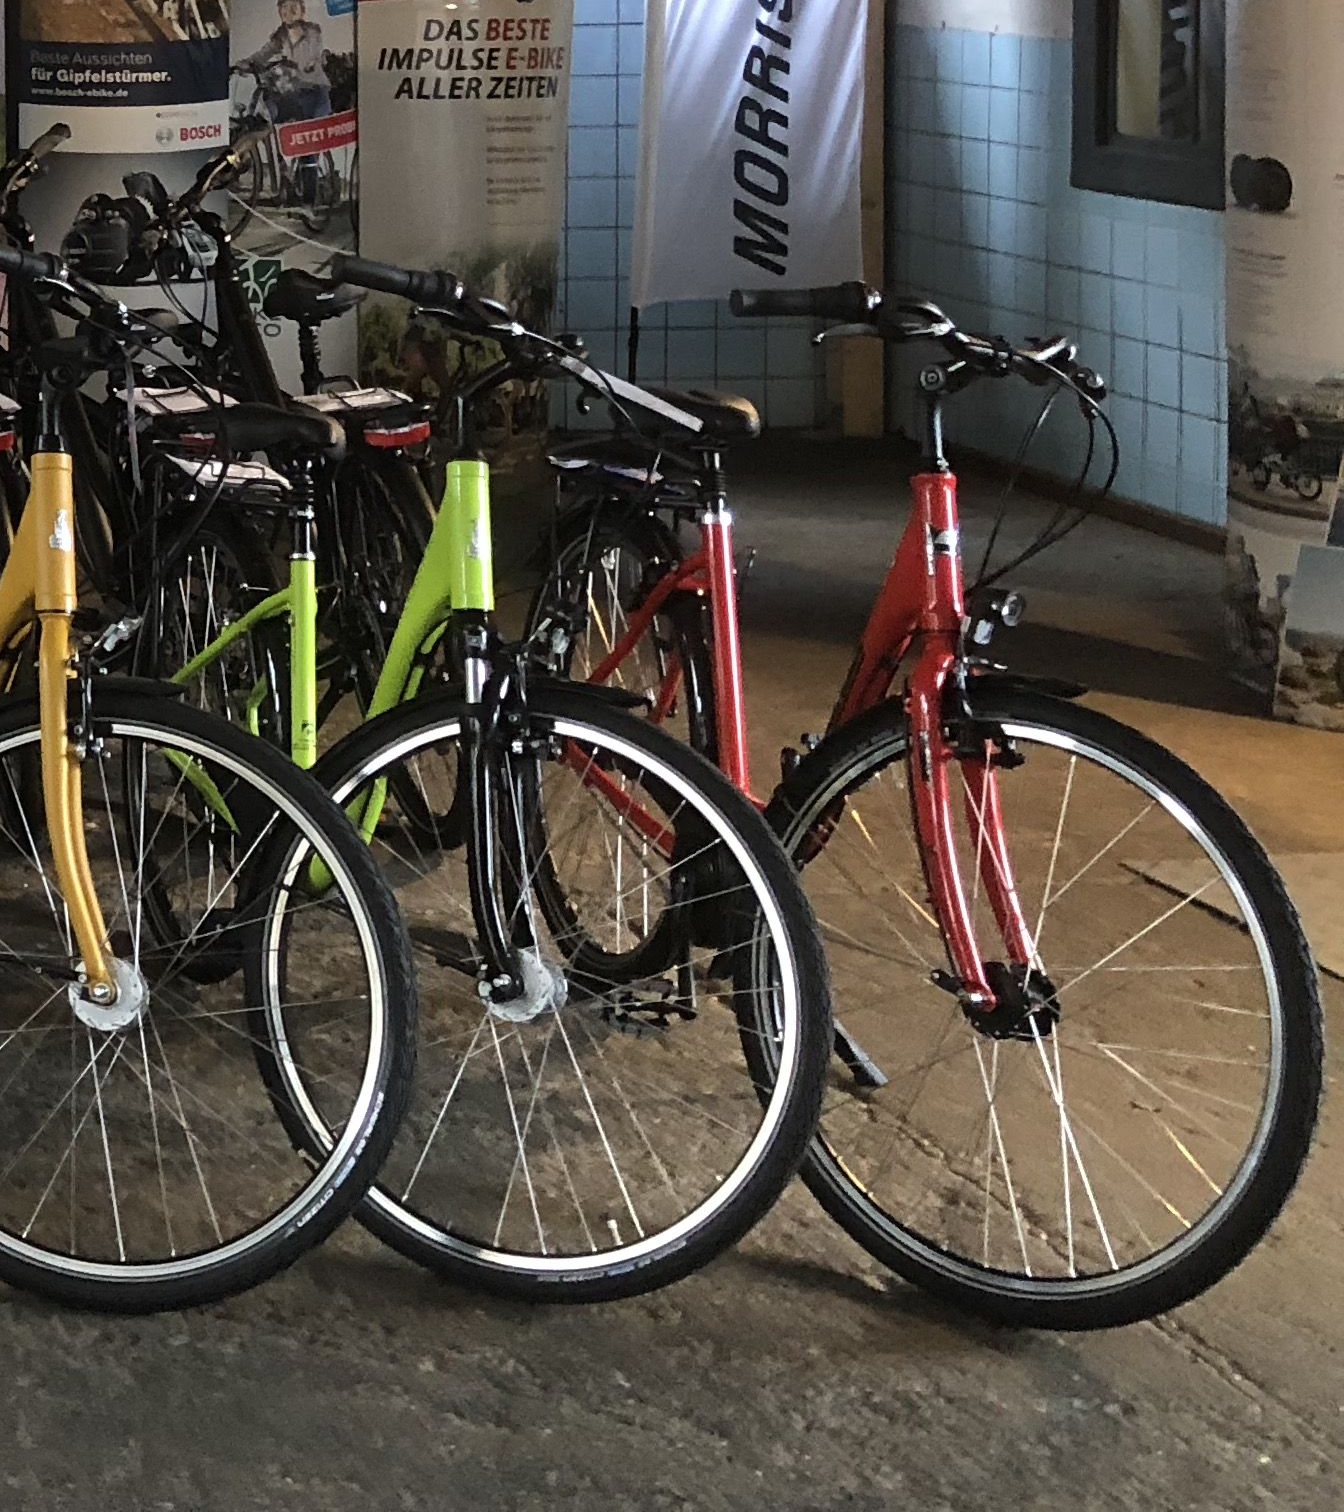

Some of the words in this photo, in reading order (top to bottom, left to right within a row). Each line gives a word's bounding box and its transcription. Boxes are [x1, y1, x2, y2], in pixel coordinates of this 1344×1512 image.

[423, 19, 480, 41] DAS
[485, 18, 552, 41] BESTE
[31, 50, 69, 65] Beste
[72, 52, 152, 66] Aussichten
[378, 47, 502, 71] IMPULSE
[505, 46, 565, 70] E-BIKE
[31, 68, 53, 81] für
[56, 68, 172, 85] Gipfelstürmer.
[395, 76, 483, 100] ALLER
[486, 76, 559, 99] ZEITEN
[179, 124, 222, 142] BOSCH
[289, 128, 325, 146] JETZT
